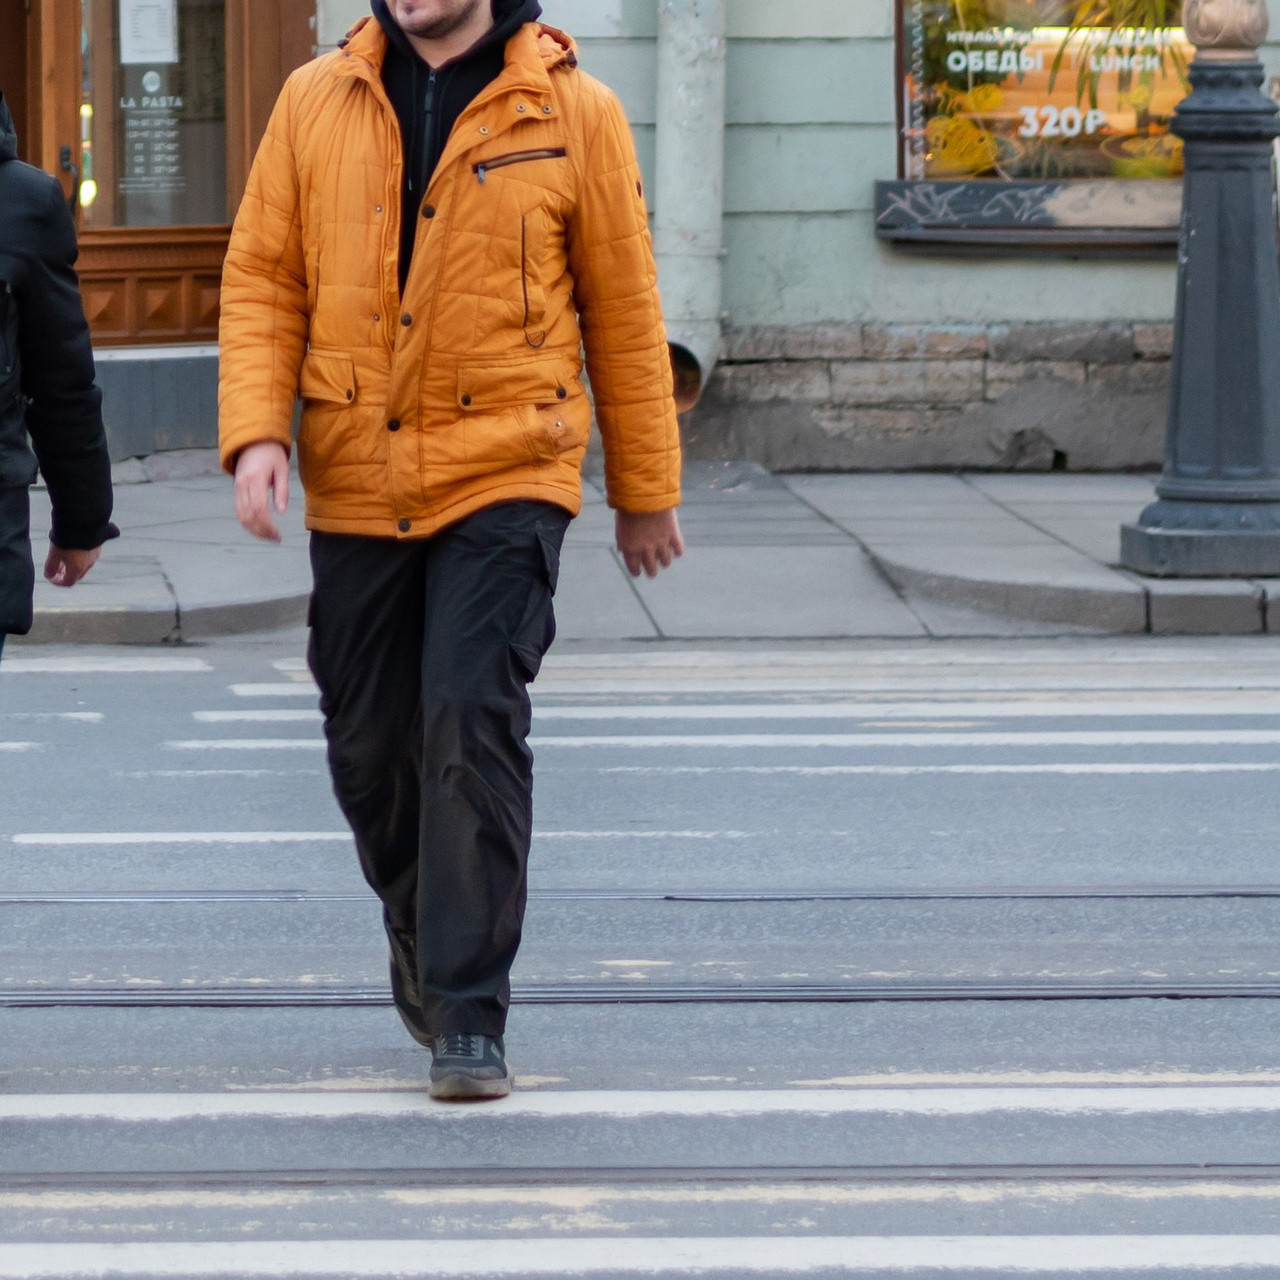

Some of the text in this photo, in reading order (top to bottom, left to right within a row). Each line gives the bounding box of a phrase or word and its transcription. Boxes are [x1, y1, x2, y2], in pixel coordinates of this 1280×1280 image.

[946, 49, 1044, 73] ОБЕДЫ
[1090, 54, 1161, 72] LUNCH
[120, 95, 183, 109] LA PASTA
